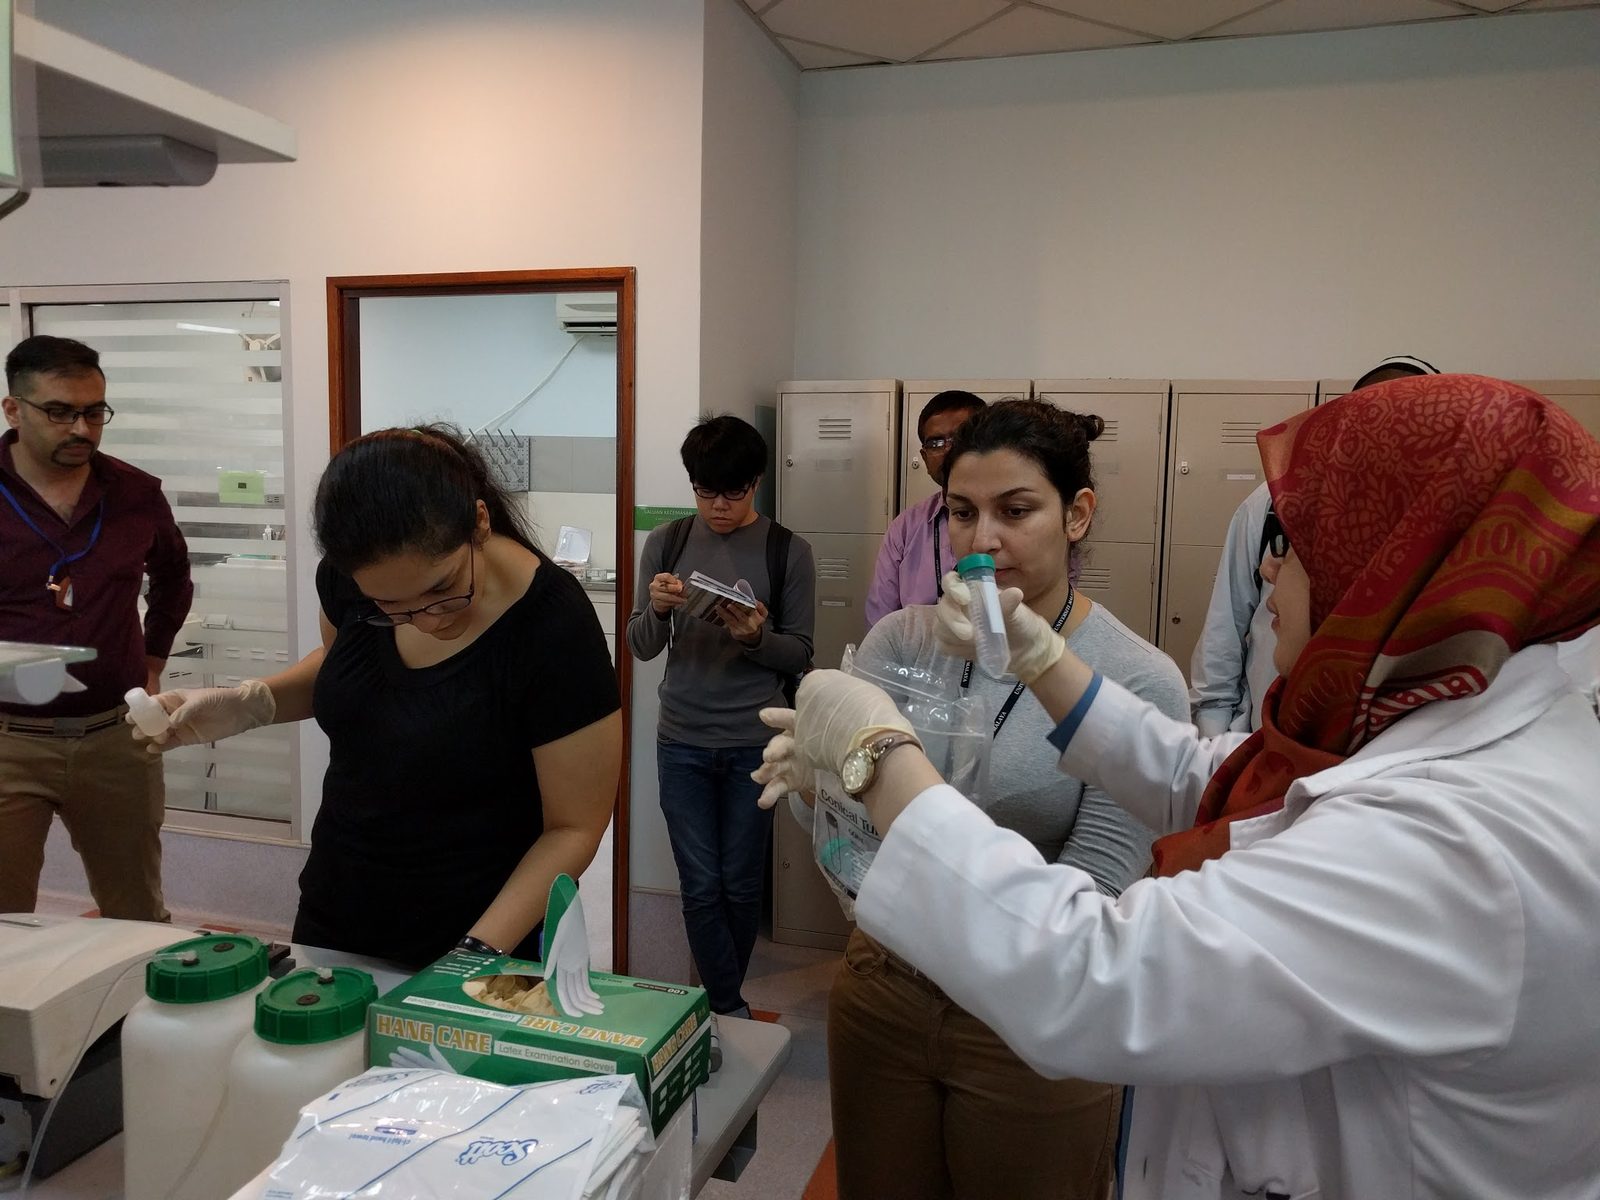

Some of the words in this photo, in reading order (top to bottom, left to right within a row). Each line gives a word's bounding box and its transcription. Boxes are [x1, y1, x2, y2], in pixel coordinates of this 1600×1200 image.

[820, 788, 858, 824] Conical
[667, 987, 686, 995] 100
[516, 1014, 580, 1036] CARE
[376, 1014, 435, 1045] HANG
[437, 1025, 492, 1056] CARE
[499, 1043, 523, 1057] Latex
[524, 1047, 581, 1067] Examination
[583, 1058, 615, 1073] Gloves
[577, 1027, 648, 1049] HANG
[458, 1138, 539, 1166] Scott
